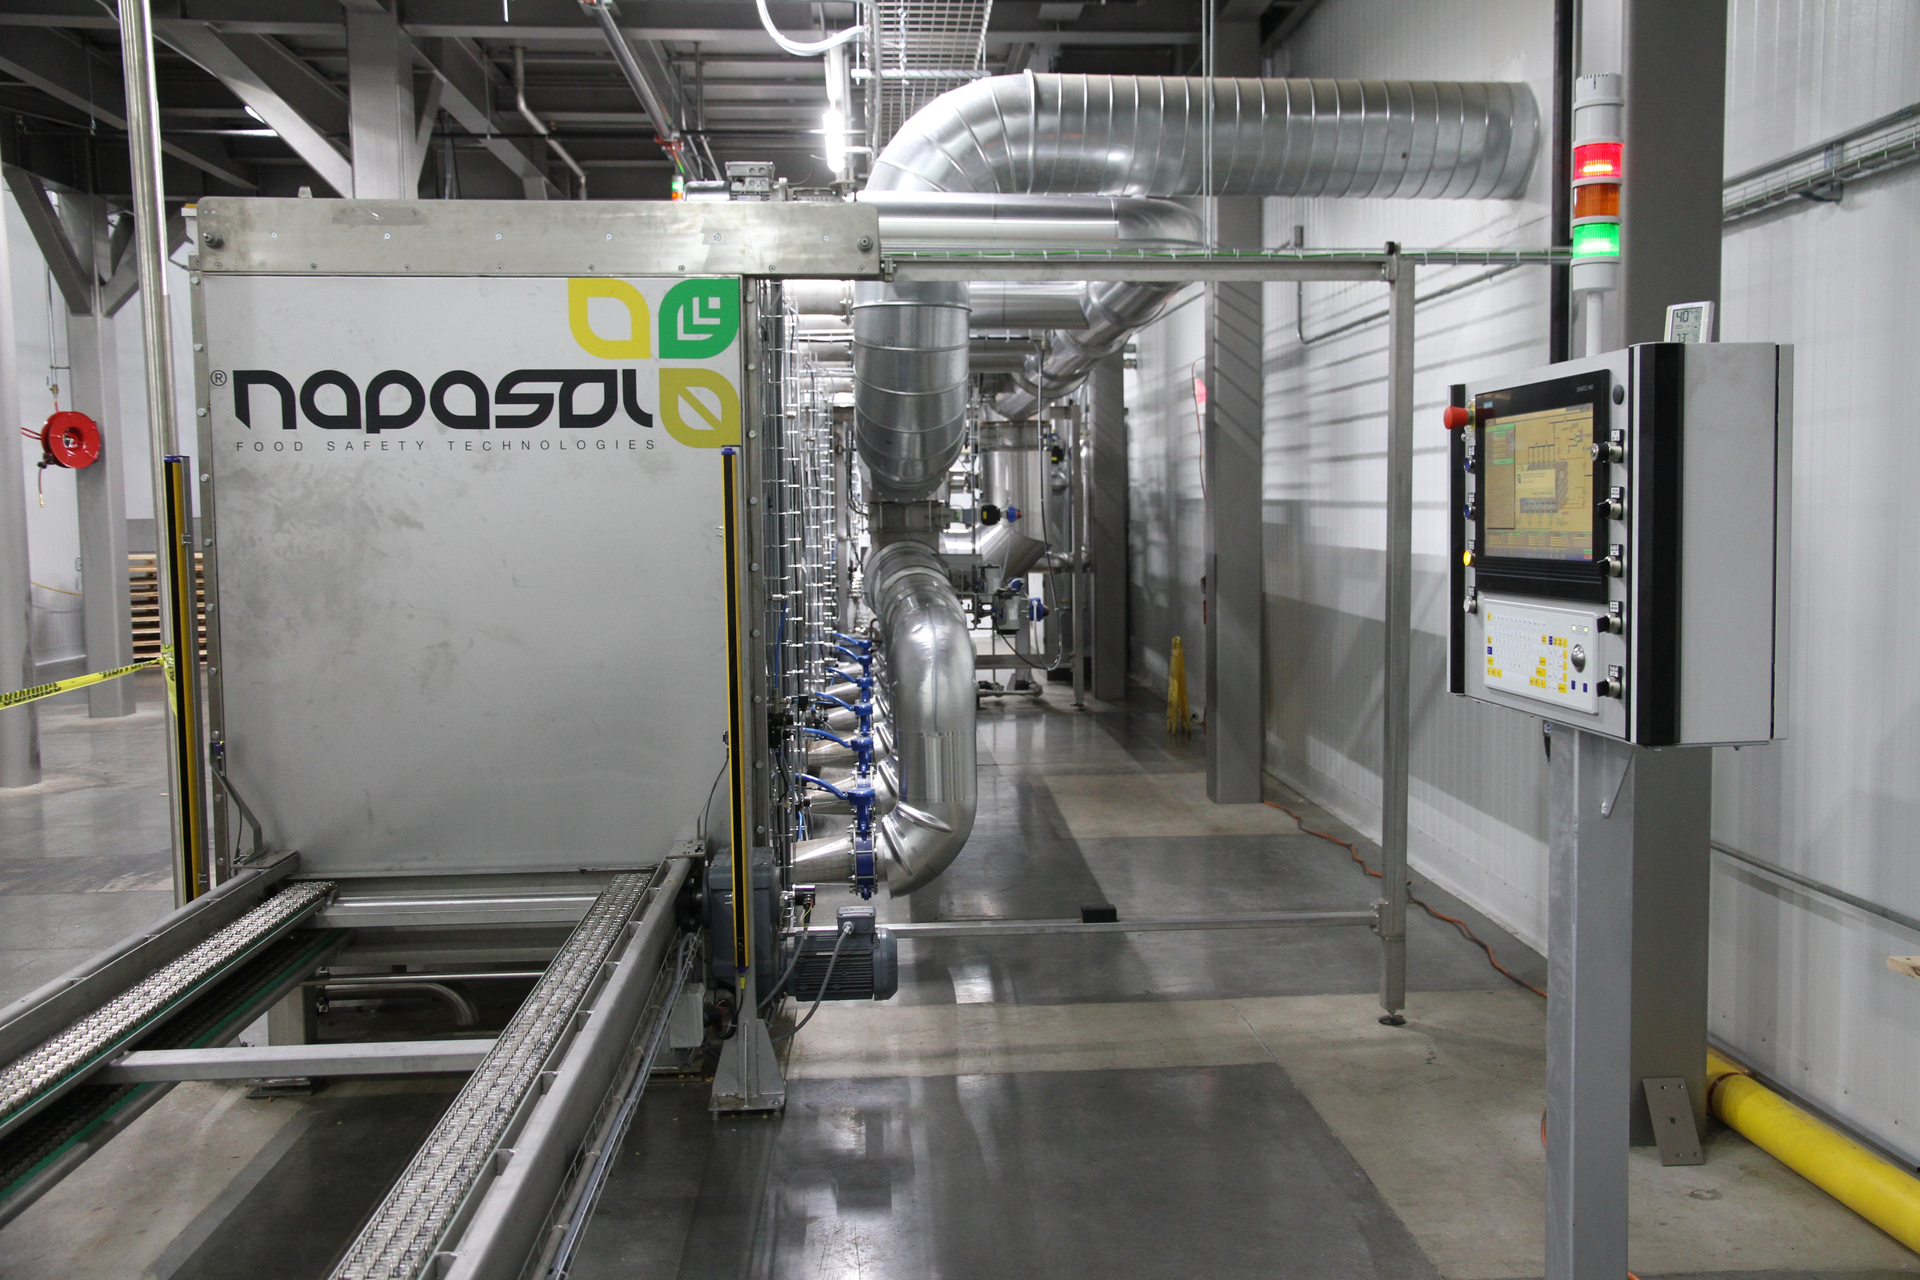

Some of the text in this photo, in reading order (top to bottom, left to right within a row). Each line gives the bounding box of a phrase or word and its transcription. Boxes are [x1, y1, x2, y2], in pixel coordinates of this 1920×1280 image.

[1676, 310, 1690, 322] 40
[235, 439, 655, 452] FOOD SAFETY TECHNOLOGIES
